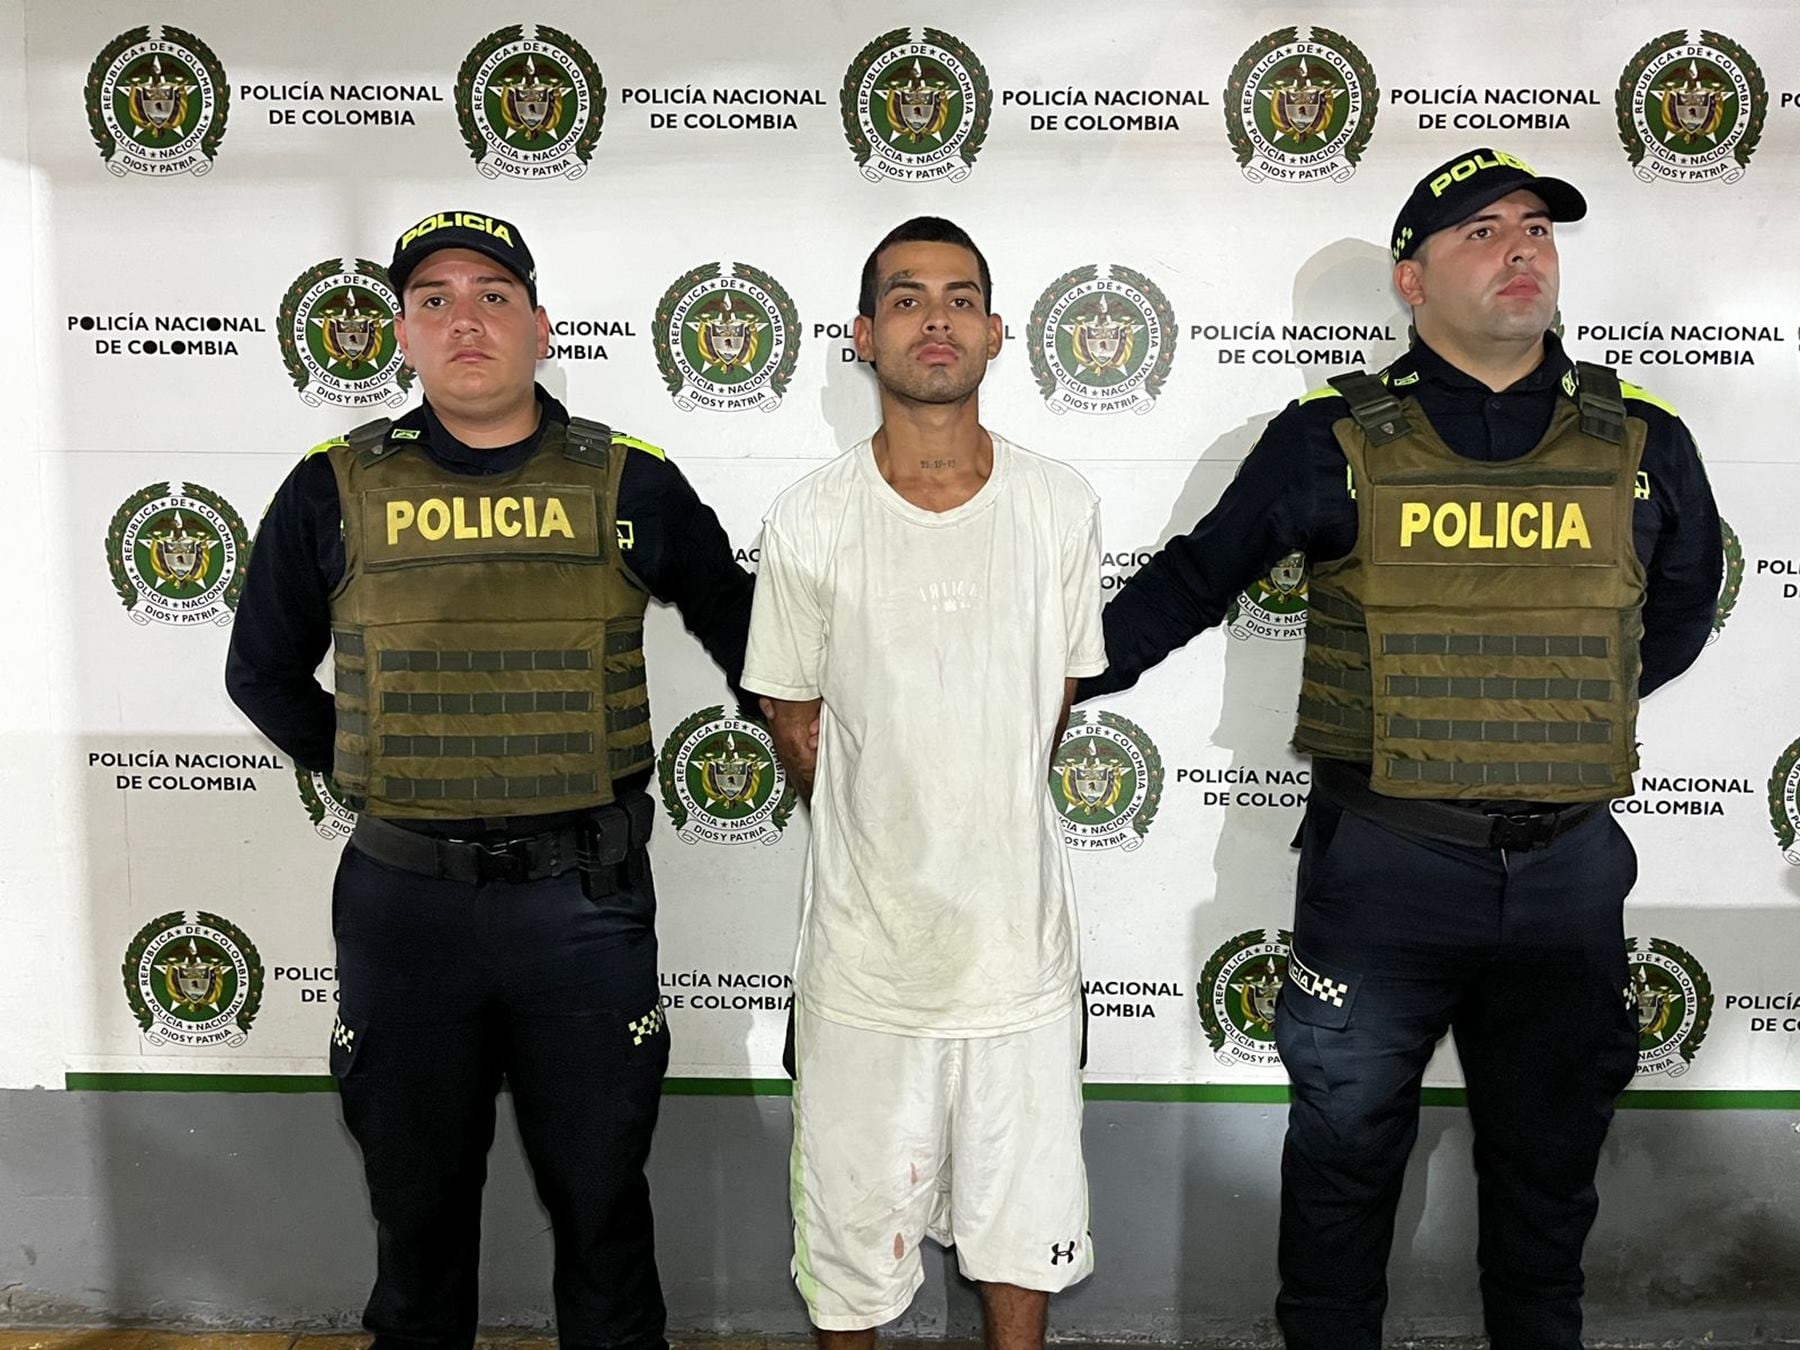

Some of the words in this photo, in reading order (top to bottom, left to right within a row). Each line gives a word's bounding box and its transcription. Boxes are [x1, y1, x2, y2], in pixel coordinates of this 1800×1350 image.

[150, 43, 165, 51] DE
[178, 48, 212, 108] COLOMBIA
[523, 43, 539, 51] DE
[552, 49, 587, 111] COLOMBIA
[911, 46, 926, 54] DE
[940, 52, 973, 113] COLOMBIA
[1297, 45, 1313, 53] DE
[1326, 50, 1359, 112] COLOMBIA
[1687, 48, 1703, 56] DE
[1716, 53, 1748, 115] COLOMBIA
[241, 81, 324, 100] POLICÍA
[331, 86, 443, 100] NACIONAL
[622, 85, 706, 104] POLICÍA
[714, 90, 826, 104] NACIONAL
[1003, 87, 1087, 105] POLICÍA
[1095, 91, 1209, 105] NACIONAL
[1392, 85, 1477, 104] POLICÍA
[1485, 90, 1600, 104] NACIONAL
[270, 110, 295, 124] DE
[303, 110, 415, 125] COLOMBIA
[651, 114, 677, 128] DE
[684, 114, 797, 129] COLOMBIA
[1031, 116, 1057, 130] DE
[1065, 116, 1179, 130] COLOMBIA
[1420, 115, 1446, 128] DE
[1454, 114, 1569, 129] COLOMBIA
[160, 121, 206, 157] NACIONAL
[533, 124, 581, 160] NACIONAL
[917, 126, 966, 163] NACIONAL
[1300, 126, 1352, 163] NACIONAL
[1691, 128, 1741, 164] NACIONAL
[122, 156, 148, 172] DIOS
[160, 156, 196, 172] PATRIA
[494, 158, 520, 175] DIOS
[533, 159, 571, 176] PATRIA
[878, 161, 904, 178] DIOS
[916, 162, 954, 179] PATRIA
[1260, 161, 1287, 178] DIOS
[1299, 162, 1338, 179] PATRIA
[1651, 161, 1678, 178] DIOS
[1690, 163, 1728, 179] PATRIA
[343, 276, 359, 284] DE
[720, 280, 736, 288] DE
[749, 285, 783, 345] COLOMBIA
[1097, 282, 1113, 290] DE
[1126, 287, 1158, 347] COLOMBIA
[69, 313, 148, 330] POLICÍA
[156, 317, 265, 332] NACIONAL
[548, 321, 636, 336] CIONAL
[1192, 322, 1275, 339] POLICÍA
[1283, 326, 1396, 340] NACIONAL
[1578, 322, 1663, 340] POLICÍA
[1671, 326, 1784, 341] NACIONAL
[96, 340, 121, 354] DE
[128, 341, 238, 355] COLOMBIA
[546, 345, 608, 360] OMBIA
[1220, 350, 1244, 363] DE
[1253, 350, 1365, 364] COLOMBIA
[1606, 350, 1632, 364] DE
[1640, 350, 1754, 365] COLOMBIA
[354, 354, 401, 389] NACIONAL
[728, 358, 776, 393] NACIONAL
[1102, 360, 1151, 396] NACIONAL
[316, 386, 342, 403] DIOS
[355, 388, 391, 404] PATRIA
[690, 391, 716, 407] DIOS
[728, 392, 765, 408] PATRIA
[1063, 394, 1089, 410] DIOS
[1101, 394, 1139, 411] PATRIA
[387, 497, 574, 545] POLICIA
[1401, 502, 1591, 549] POLICIA
[199, 504, 234, 562] COLOMBIA
[182, 574, 228, 608] NACIONAL
[145, 605, 171, 621] DIOS
[183, 607, 219, 622] PATRIA
[1246, 620, 1272, 636] DIOS
[89, 750, 169, 767] POLICÍA
[175, 755, 283, 768] NACIONAL
[1114, 732, 1146, 789] COLOMBIA
[117, 776, 142, 789] DE
[149, 776, 256, 790] COLOMBIA
[1178, 766, 1259, 784] POLICÍA
[1642, 778, 1753, 793] NACIONAL
[1205, 792, 1230, 805] DE
[1236, 793, 1309, 808] COLOM
[1612, 800, 1724, 815] COLOMBIA
[731, 794, 778, 827] NACIONAL
[1091, 800, 1139, 833] NACIONAL
[694, 825, 719, 840] DIOS
[730, 826, 766, 841] PATRIA
[1090, 833, 1127, 847] PATRIA
[213, 932, 246, 987] COLOMBIA
[660, 970, 712, 987] LICÍA
[718, 974, 792, 988] NACION
[1664, 959, 1695, 1015] COLOMBIA
[302, 989, 326, 1002] DE
[196, 998, 241, 1030] NACIONAL
[1090, 1003, 1156, 1018] OMBIA
[1751, 1018, 1776, 1031] DE
[160, 1027, 185, 1043] DIOS
[197, 1029, 232, 1043] PATRIA
[1231, 1047, 1256, 1063] DIOS
[1637, 1058, 1674, 1073] PATRIA
